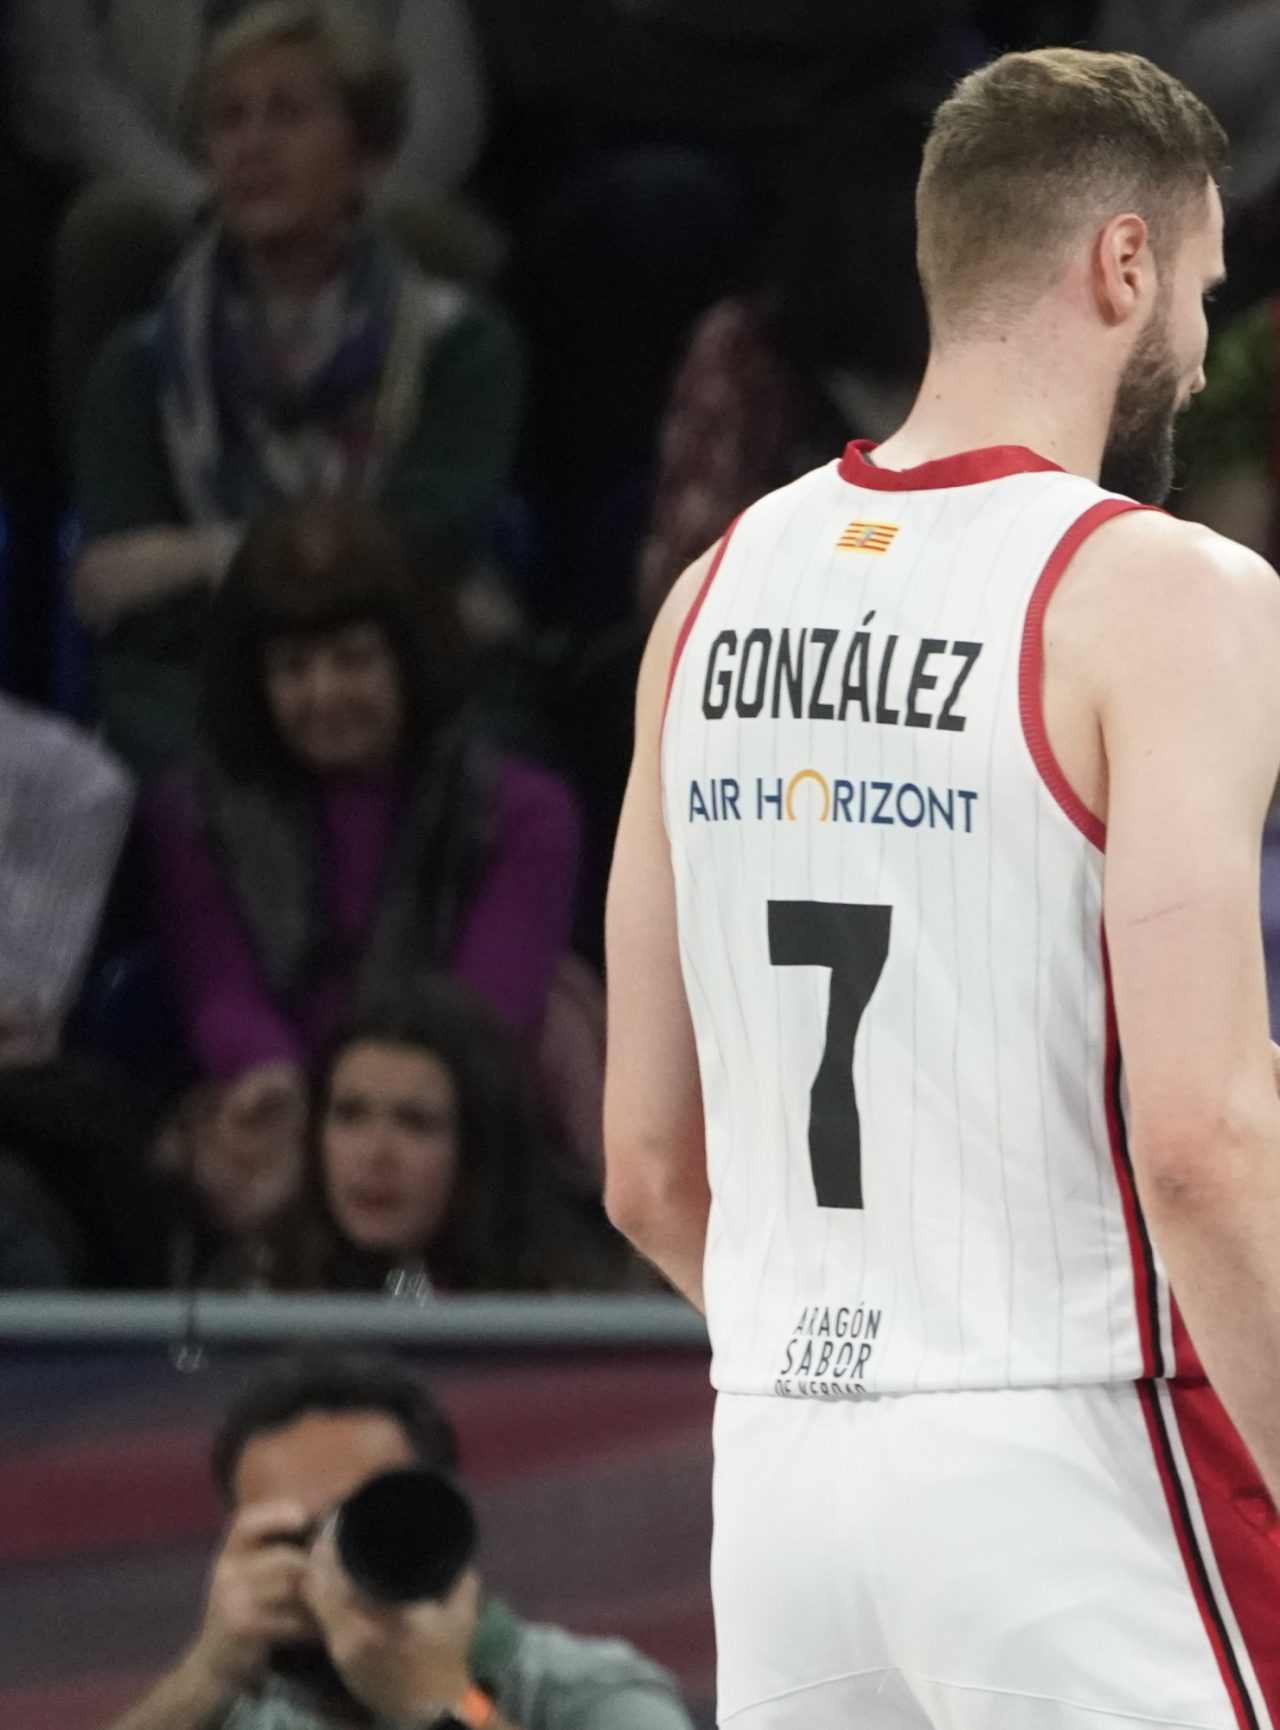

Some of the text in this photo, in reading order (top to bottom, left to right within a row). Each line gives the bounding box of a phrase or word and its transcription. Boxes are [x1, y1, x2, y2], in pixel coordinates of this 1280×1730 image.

[702, 610, 983, 732] GONZÁLEZ
[689, 769, 978, 833] AIR HORIZONT
[767, 900, 893, 1210] 7
[795, 1301, 882, 1340] ARAGÓN
[781, 1339, 872, 1379] SABOR
